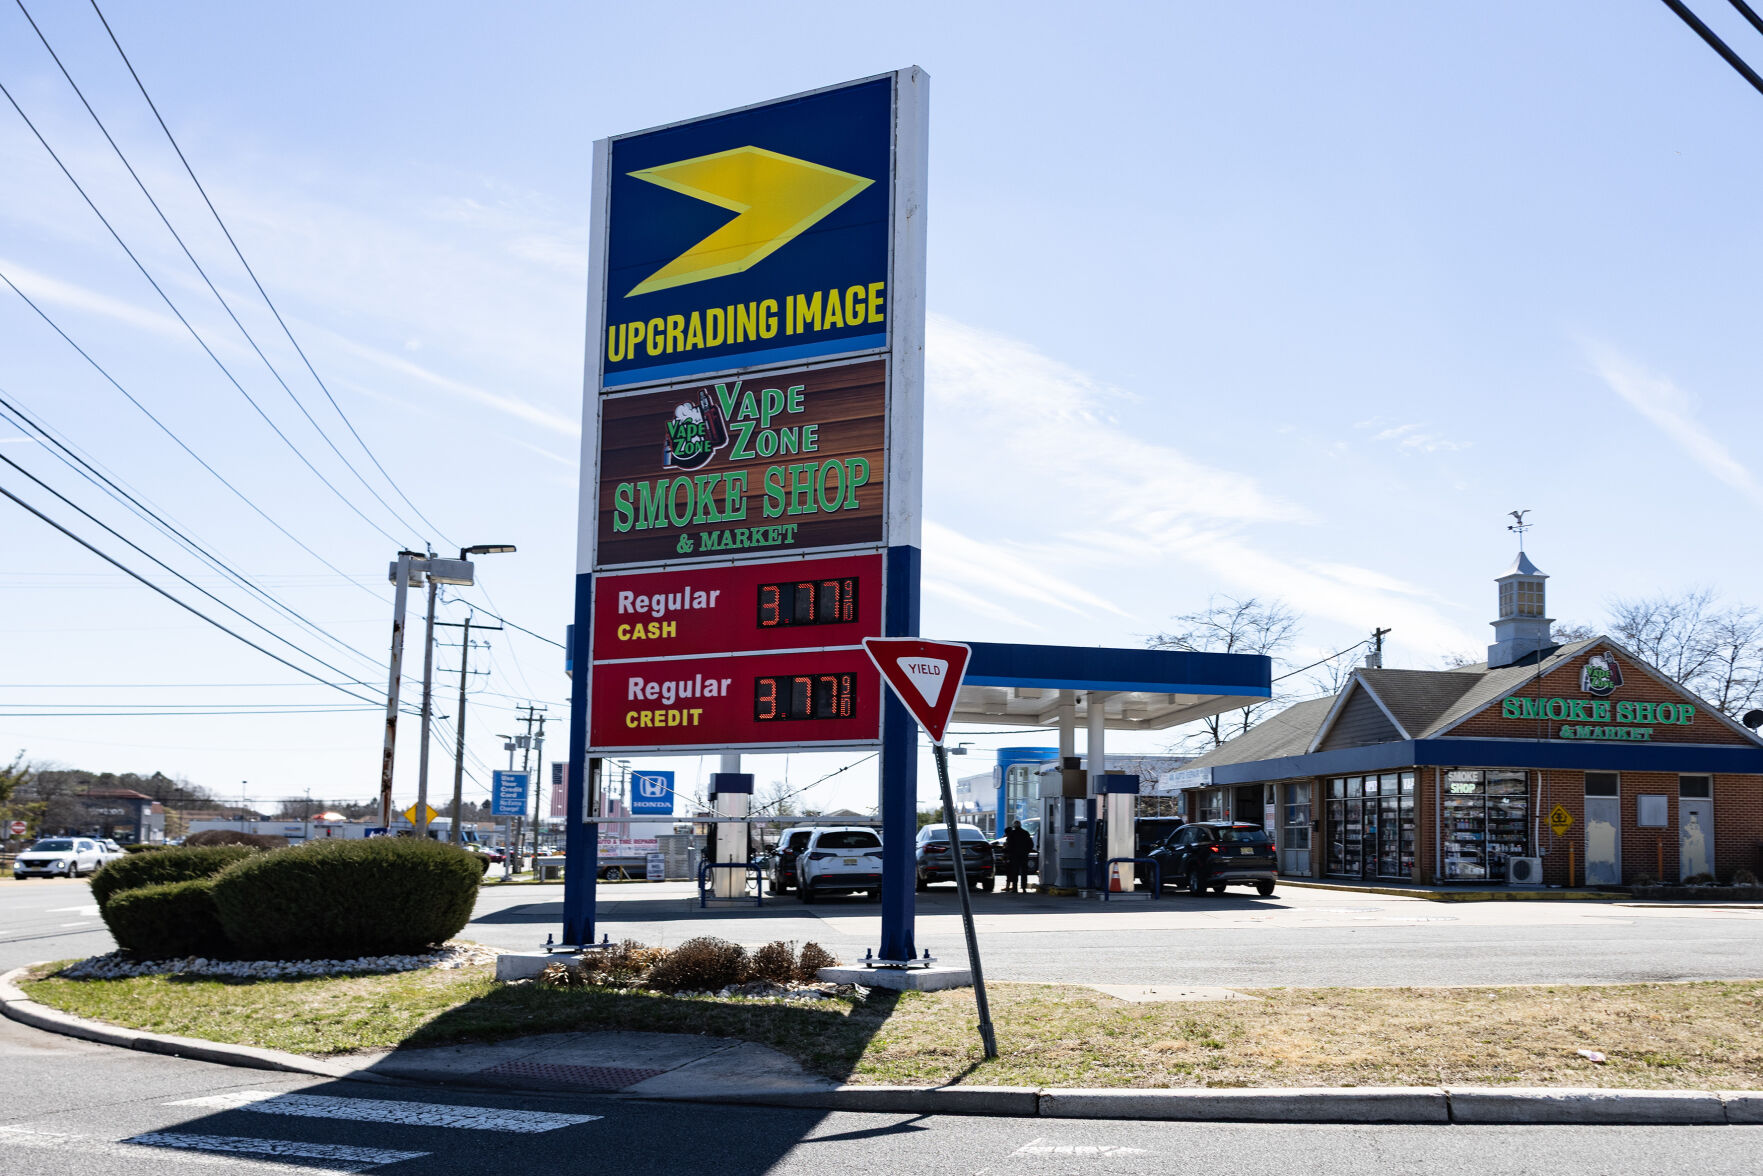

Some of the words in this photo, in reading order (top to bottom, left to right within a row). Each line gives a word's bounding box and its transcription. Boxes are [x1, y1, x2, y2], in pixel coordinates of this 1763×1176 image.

[608, 298, 779, 362] UPGRADING
[786, 281, 885, 336] IMAGE
[613, 470, 748, 533] SMOKE
[763, 456, 870, 518] SHOP
[676, 533, 694, 554] &
[699, 523, 798, 552] MARKET
[618, 586, 720, 617] Regular
[617, 621, 677, 641] CASH
[908, 663, 941, 676] YIELD
[628, 674, 732, 705] Regular
[625, 708, 703, 728] CREDIT
[1502, 696, 1611, 722] SMOKE
[1616, 701, 1696, 725] SHOP
[1576, 725, 1654, 741] MARKET
[1447, 771, 1479, 782] SMOKE
[1450, 782, 1476, 794] SHOP
